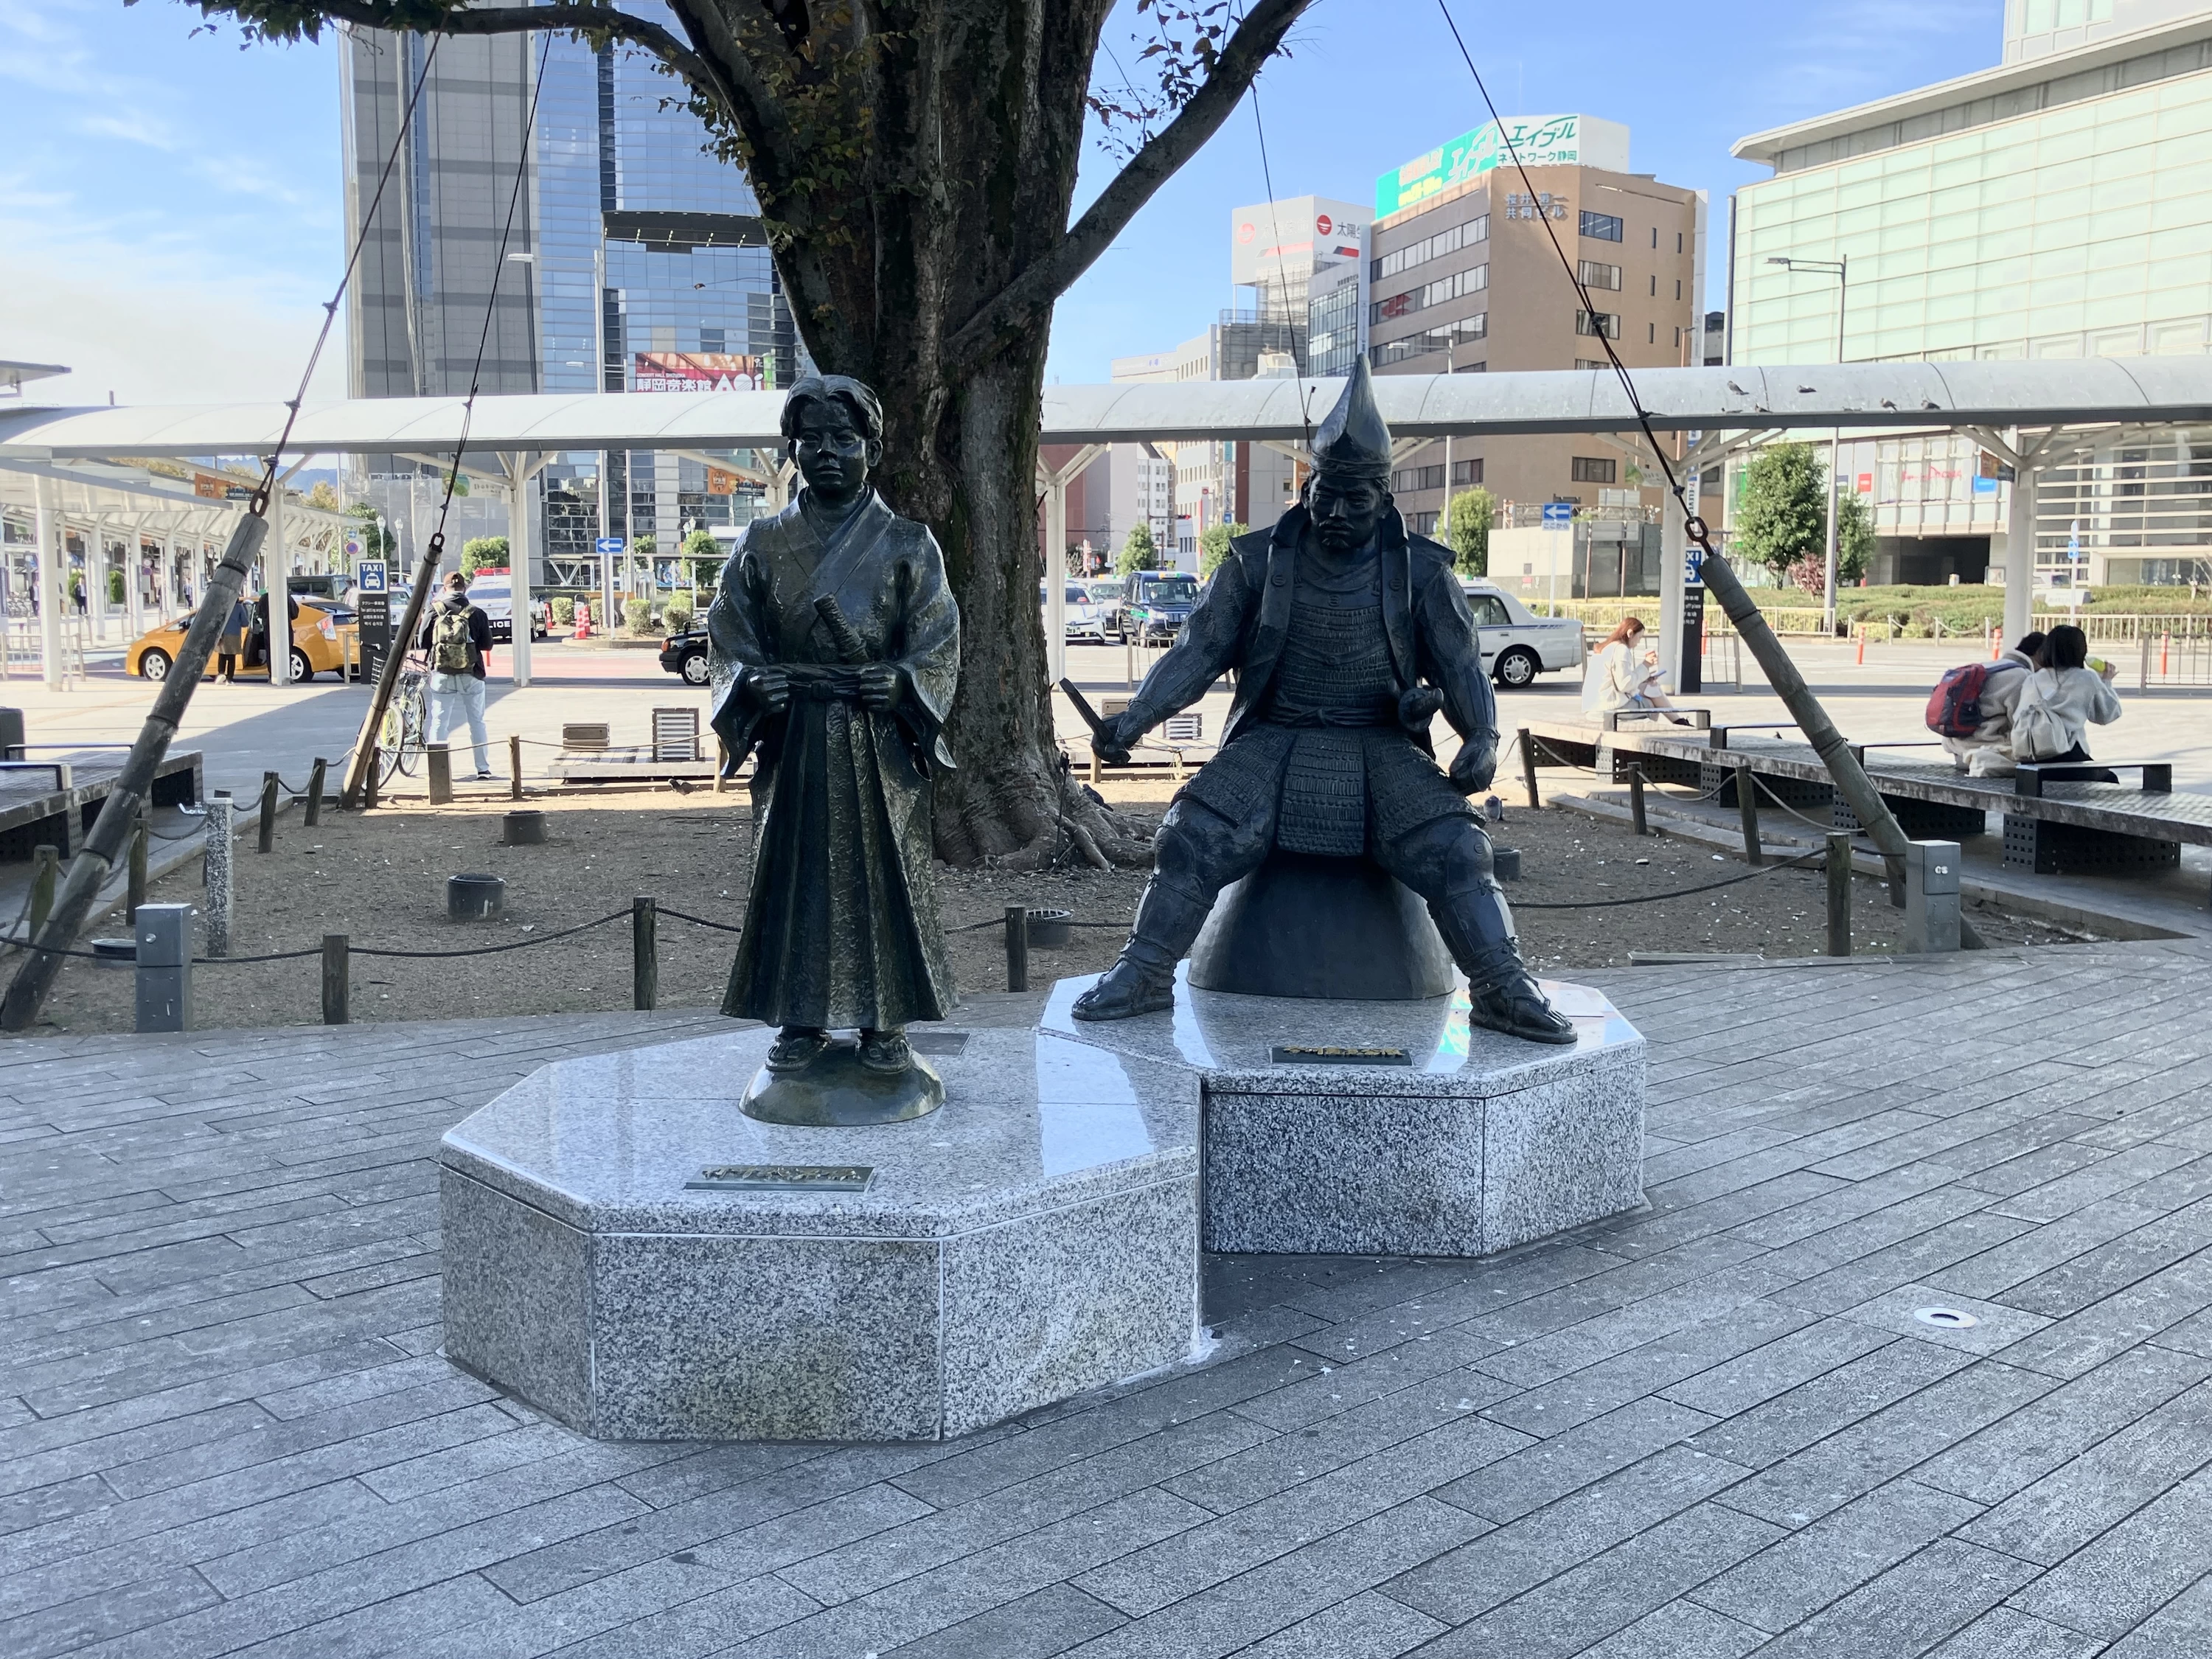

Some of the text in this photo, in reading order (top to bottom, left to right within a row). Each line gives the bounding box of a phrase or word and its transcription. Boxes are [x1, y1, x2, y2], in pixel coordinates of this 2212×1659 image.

[1499, 116, 1579, 150] エイブル
[636, 378, 712, 392] 静岡音楽館
[1686, 552, 1699, 561] XI
[361, 563, 383, 572] TAXI
